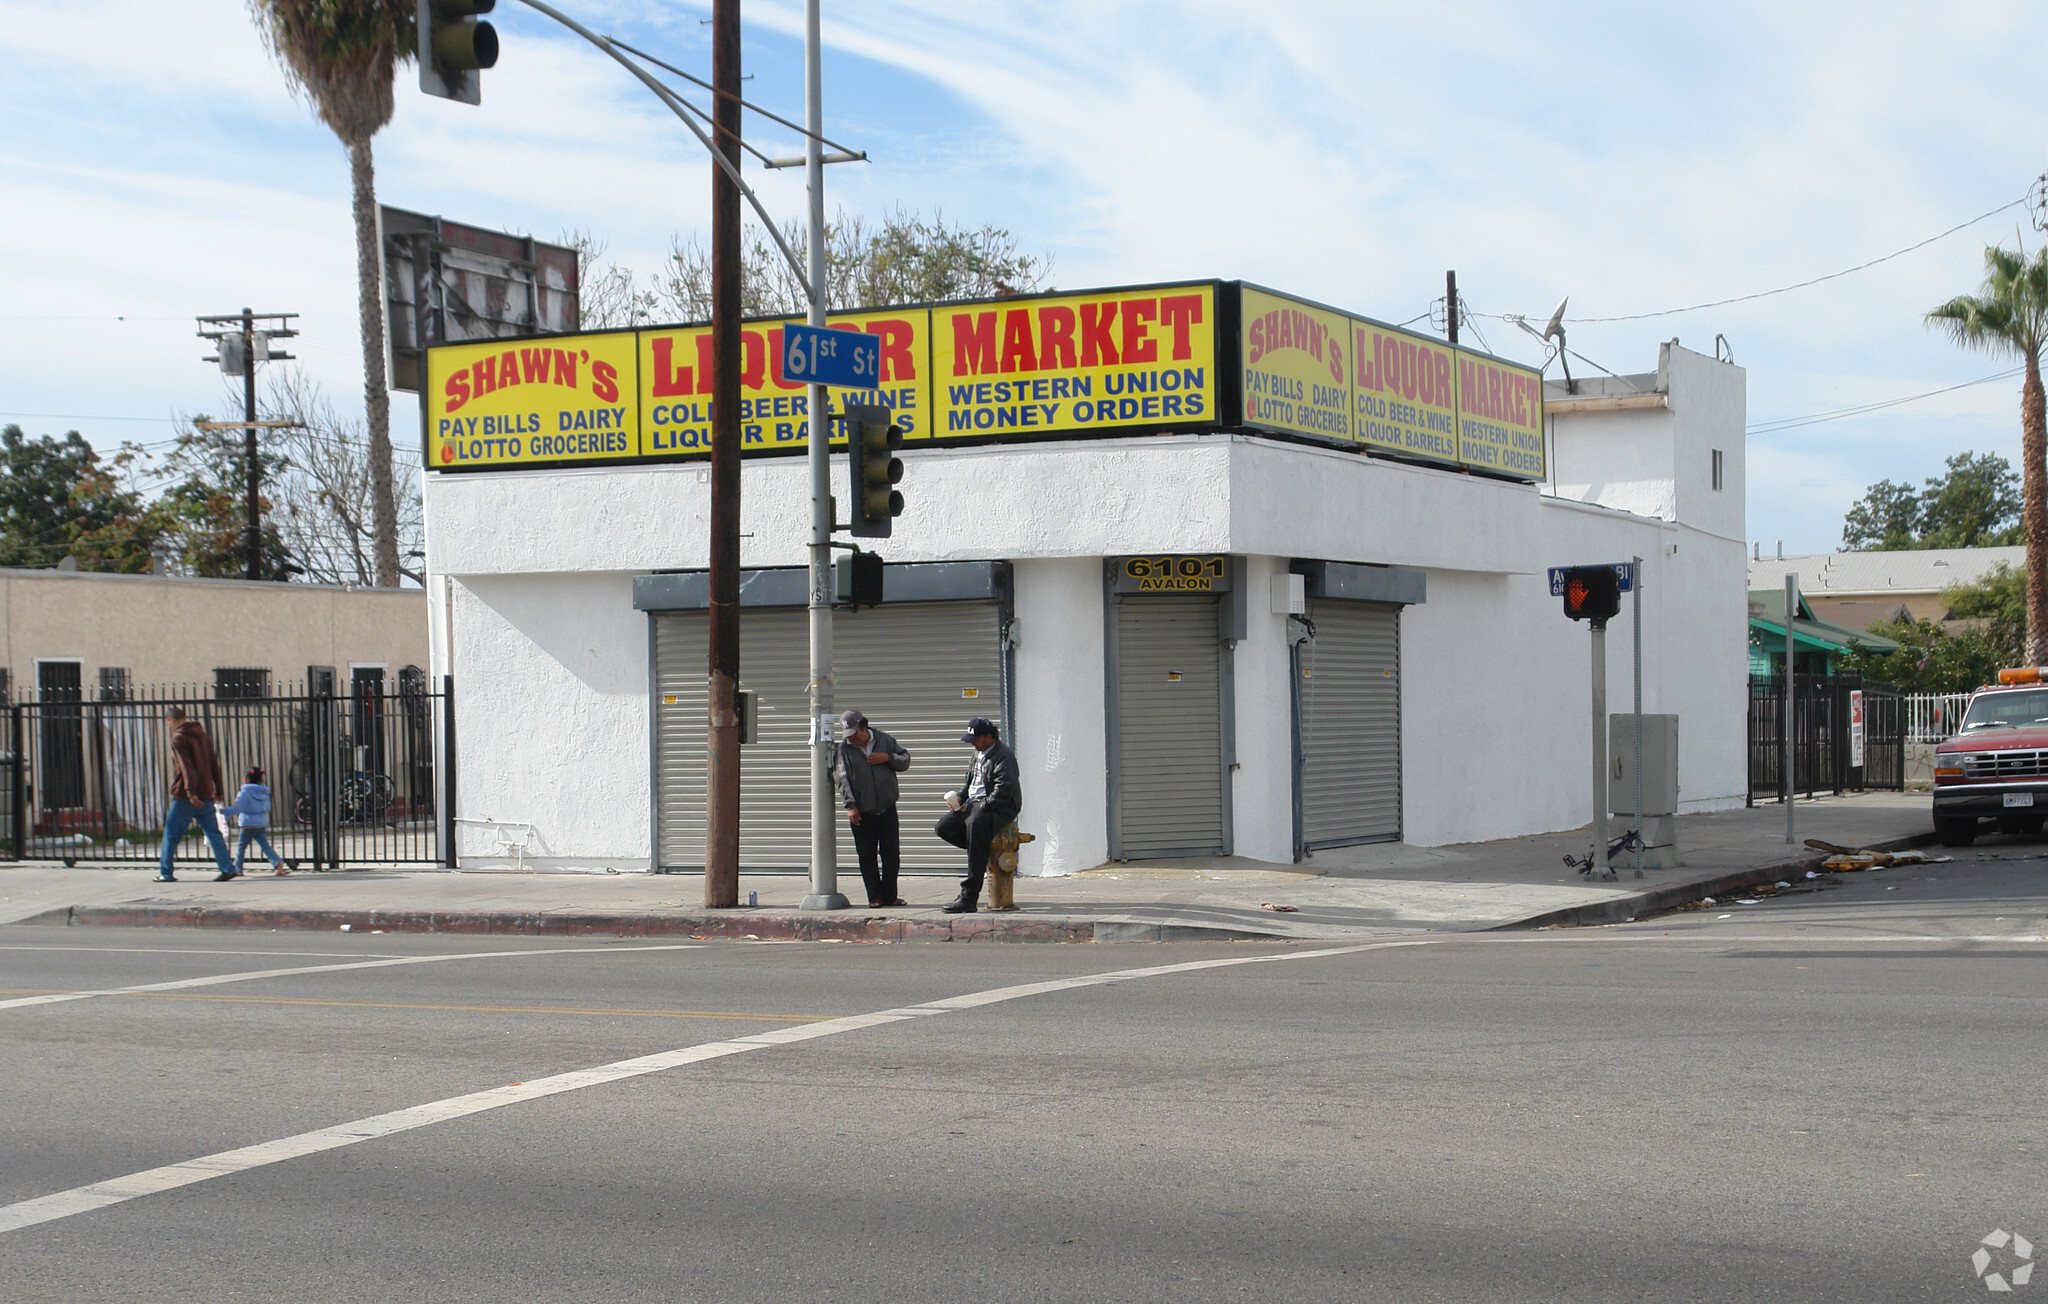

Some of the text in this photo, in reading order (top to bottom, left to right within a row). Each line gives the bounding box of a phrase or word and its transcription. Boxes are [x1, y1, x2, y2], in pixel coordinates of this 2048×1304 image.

[788, 333, 875, 376] 61st St
[952, 294, 1203, 377] MARKET
[1250, 309, 1343, 385] SHAWN'S
[445, 348, 619, 413] SHAWN'S
[949, 367, 1204, 406] WESTERN UNION
[1356, 328, 1452, 409] LIQUOR
[1246, 369, 1347, 410] PAY BILLS DAIRY
[1460, 358, 1539, 429] MARKET
[439, 407, 626, 438] PAY BILLS DAIRY
[652, 404, 712, 425] COL
[949, 394, 1204, 431] MONEY ORDERS
[1257, 396, 1293, 423] LOTTO
[1297, 403, 1348, 434] GROCERIES
[1358, 394, 1452, 434] COLD BEER & WINE
[459, 438, 521, 459] LOTTO
[530, 431, 627, 456] GROCERIES
[653, 425, 763, 449] LIQUR
[1359, 418, 1453, 456] LIQUOR BARRELS
[1462, 419, 1541, 453] WESTERN UNION
[1463, 440, 1542, 473] MONEY ORDERS
[1126, 557, 1224, 578] 6101
[1139, 577, 1211, 591] AVALON
